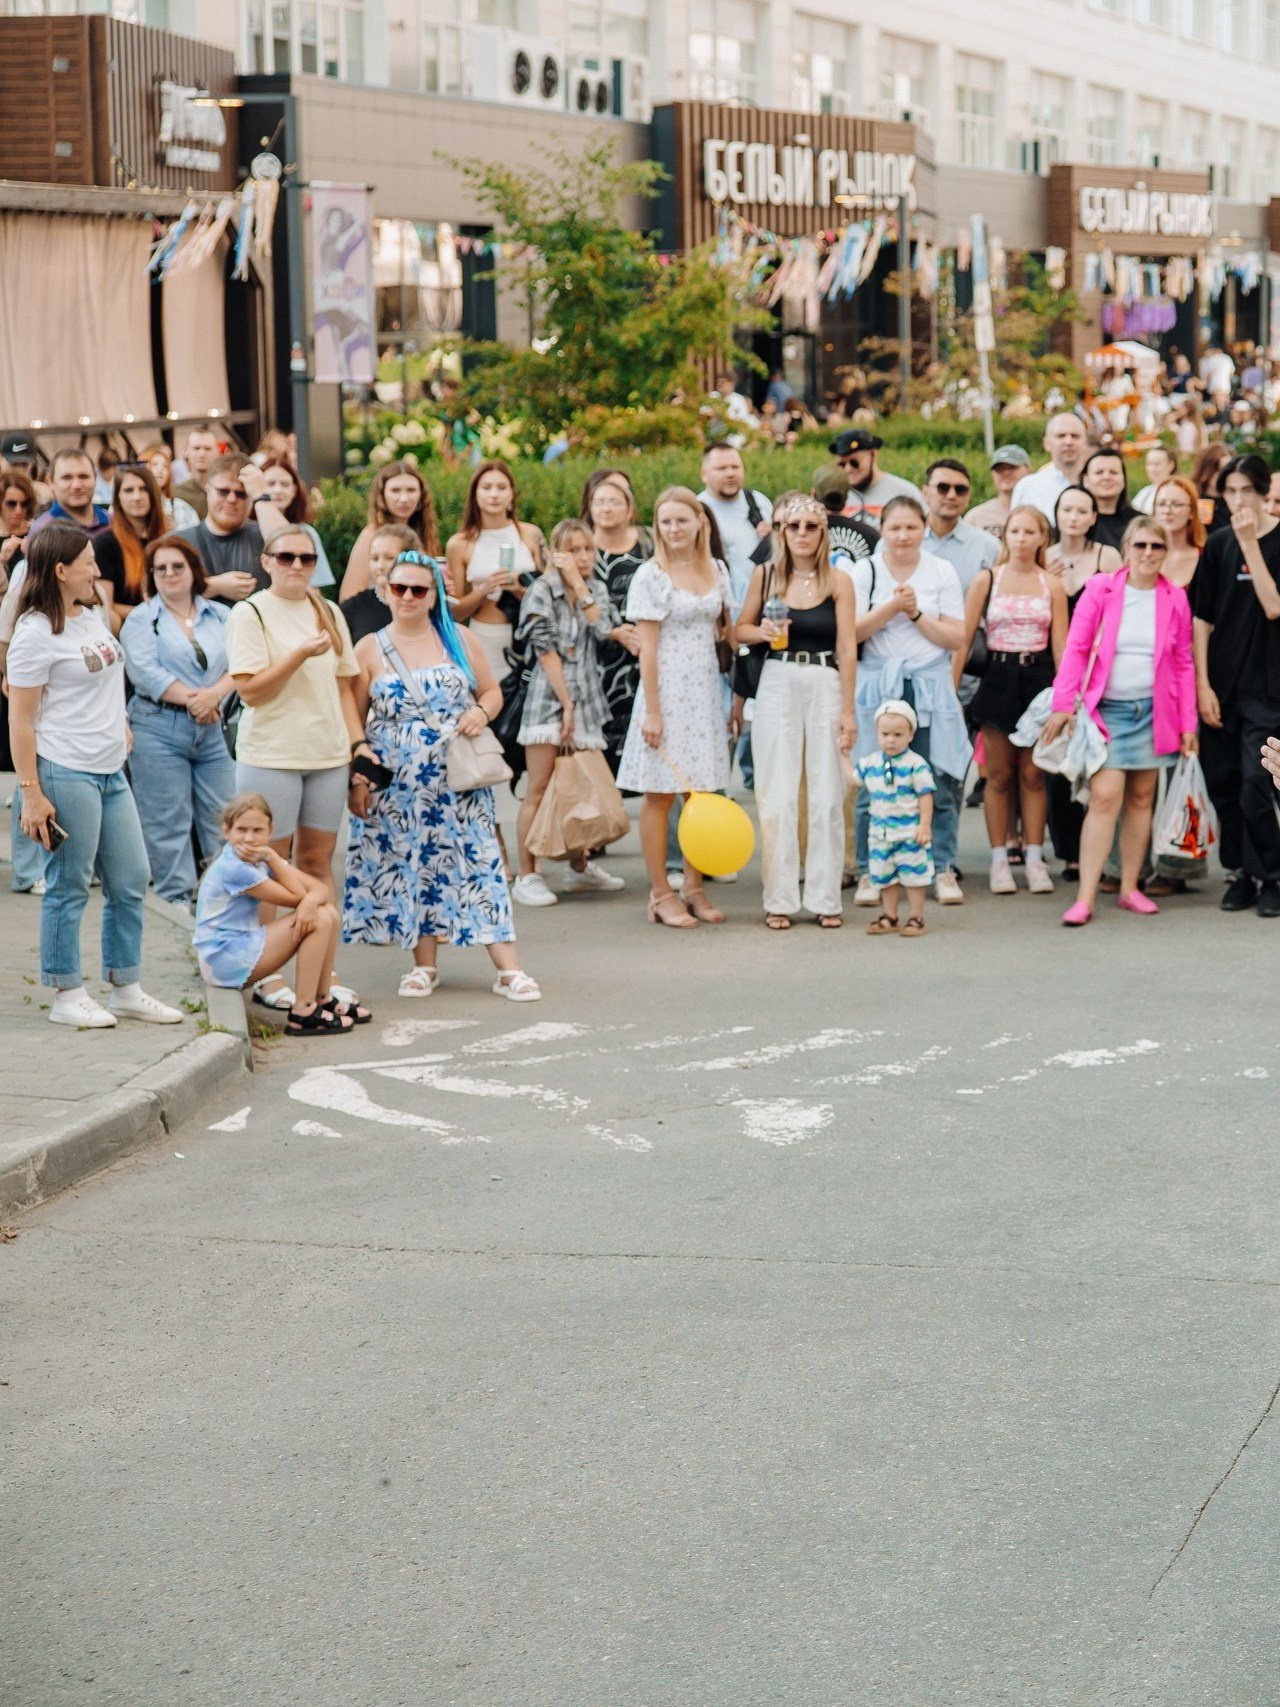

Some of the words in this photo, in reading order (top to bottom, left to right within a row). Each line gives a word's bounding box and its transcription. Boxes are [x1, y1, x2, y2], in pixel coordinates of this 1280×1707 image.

[704, 133, 814, 207] БЕЛЫЙ
[818, 149, 917, 211] РЫНОК
[1079, 181, 1149, 235] БЕЛЫЙ
